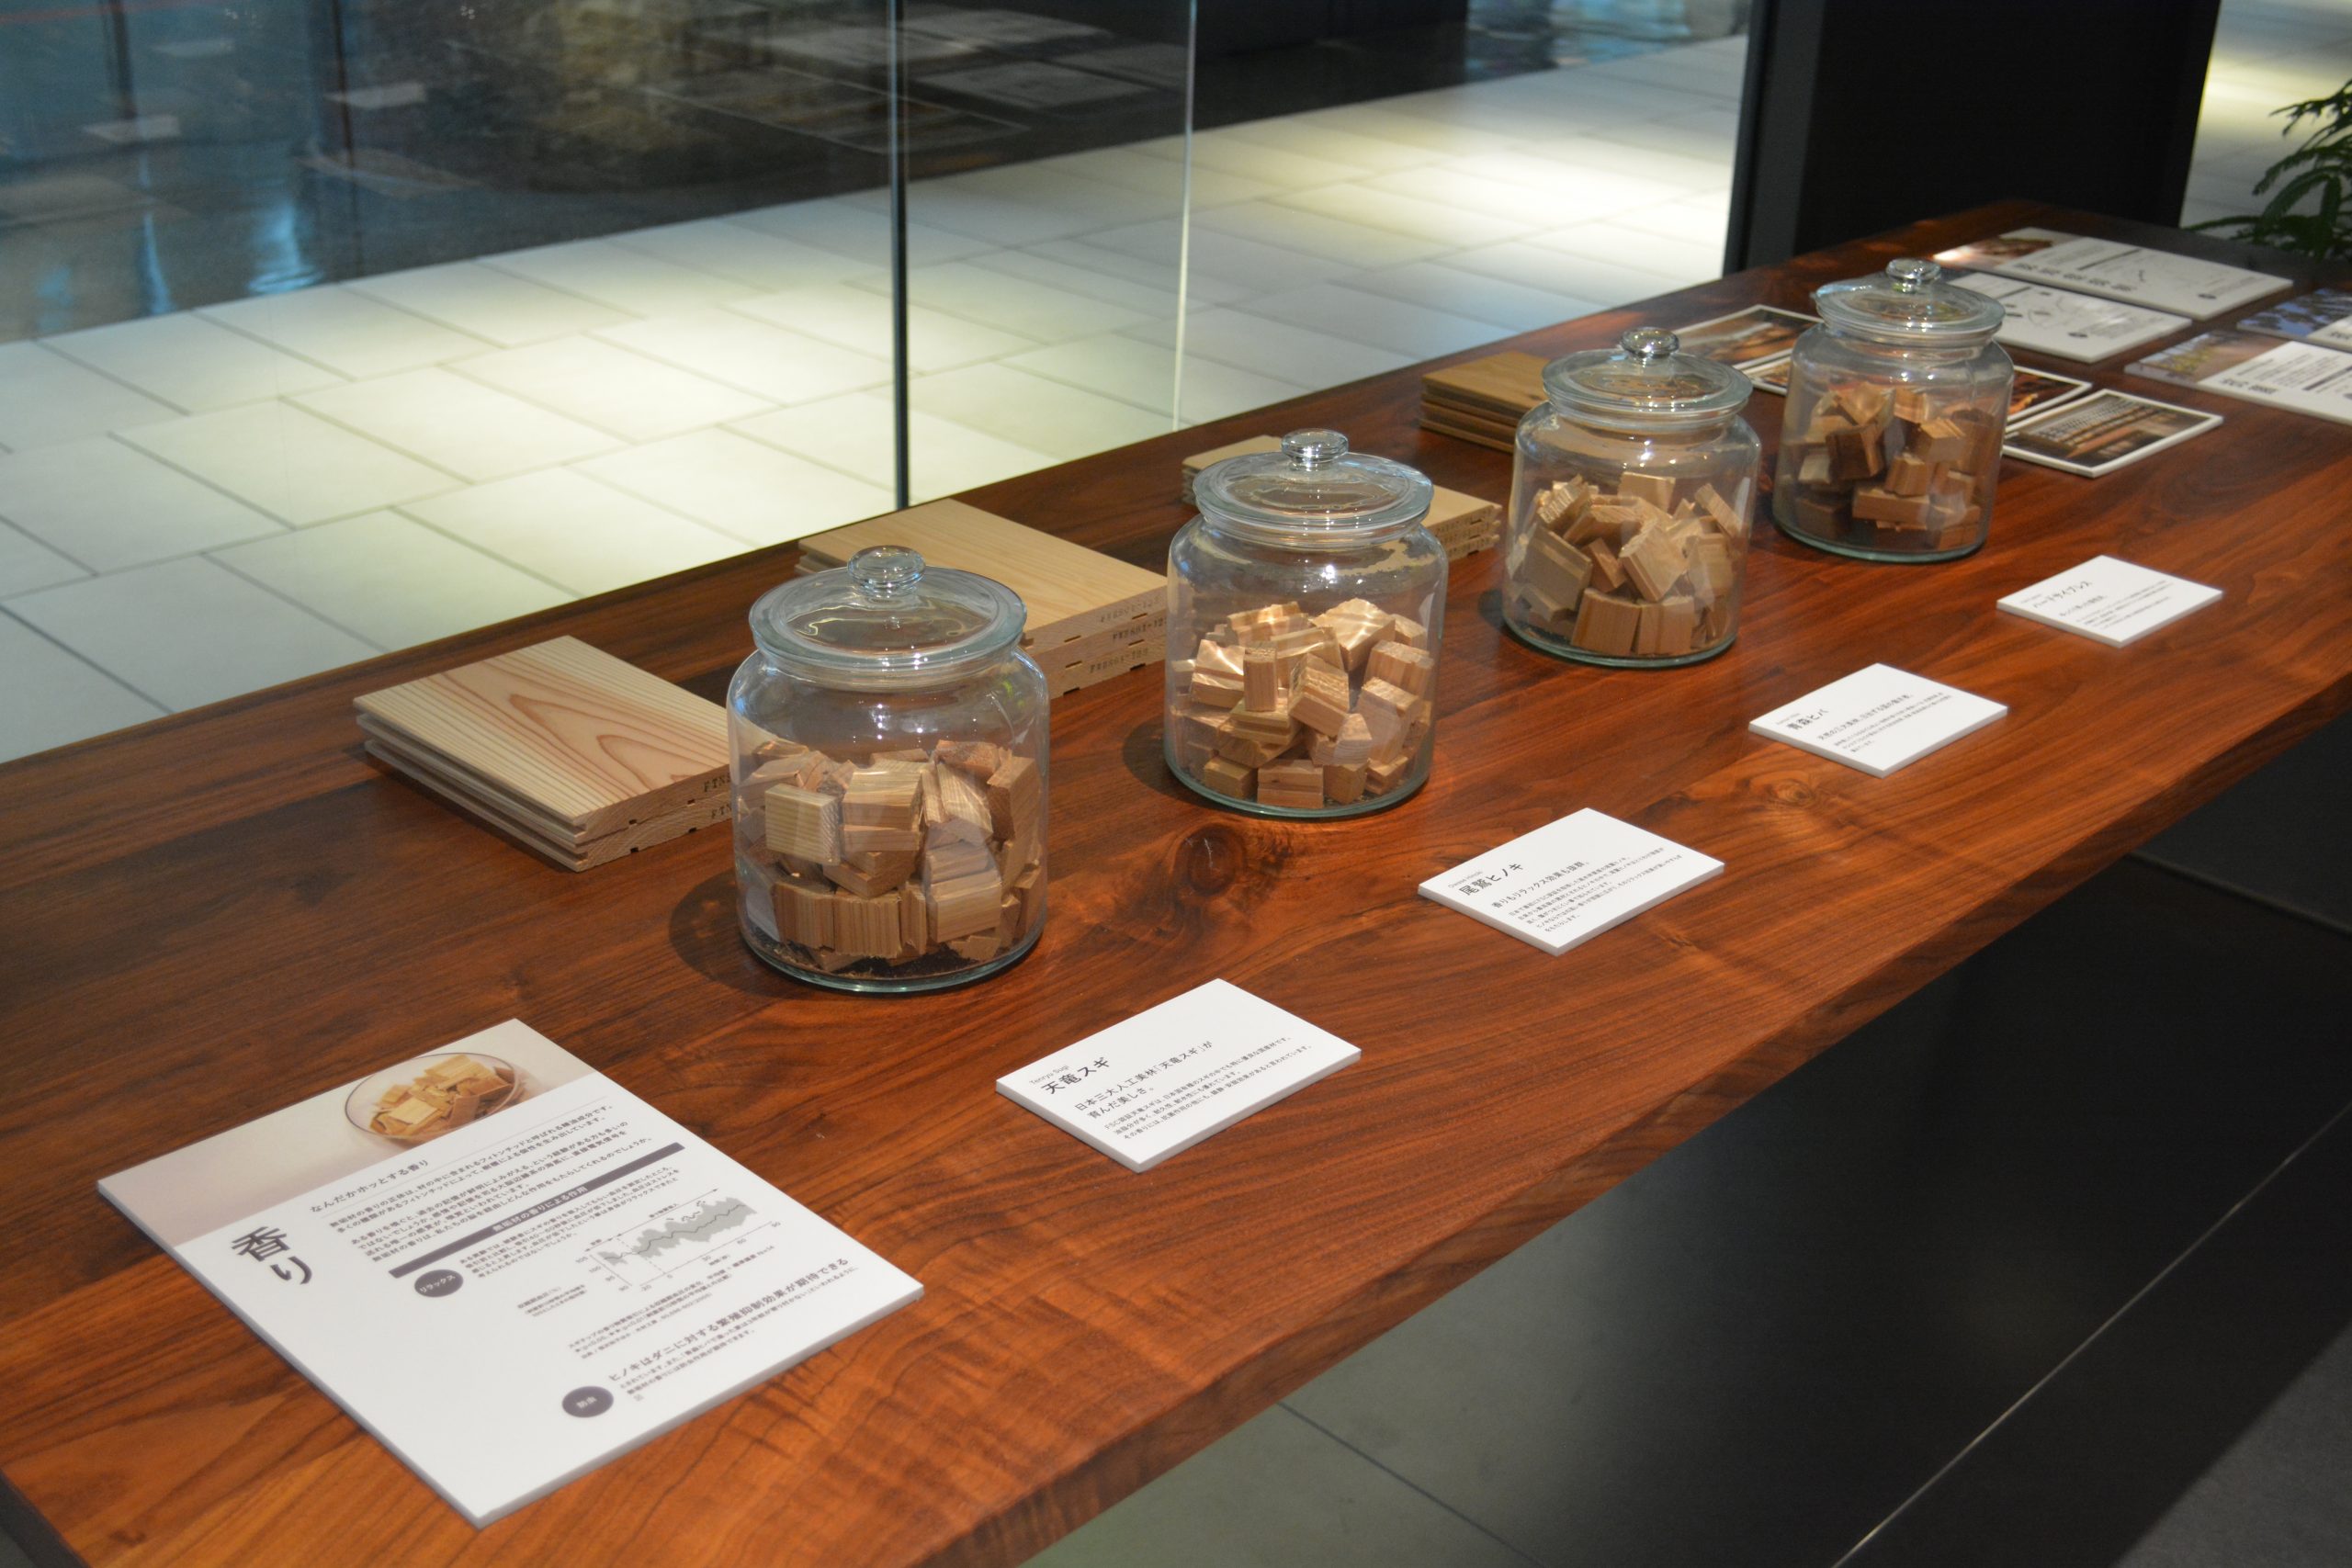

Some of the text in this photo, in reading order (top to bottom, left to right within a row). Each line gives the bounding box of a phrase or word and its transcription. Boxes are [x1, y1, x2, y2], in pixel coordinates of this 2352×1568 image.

[1459, 864, 1522, 896] 尾鷲ヒノキ
[1492, 862, 1588, 908] 香りもリラックス効果も抜群。
[1042, 1057, 1109, 1094] 天竜スギ
[1075, 1042, 1211, 1111] 日本三大人工美林「天竜スギ」が
[1088, 1089, 1153, 1118] 育んだ美しさ。
[310, 1160, 428, 1212] なんだかホッとする香り
[492, 1187, 587, 1231] 無垢材の香りによる作用
[230, 1224, 313, 1286] 香り
[420, 1275, 455, 1292] リラックス
[609, 1258, 848, 1381] ヒノキはダニに対する繁殖抑制効果が期待できる
[577, 1397, 596, 1408] 防虫
